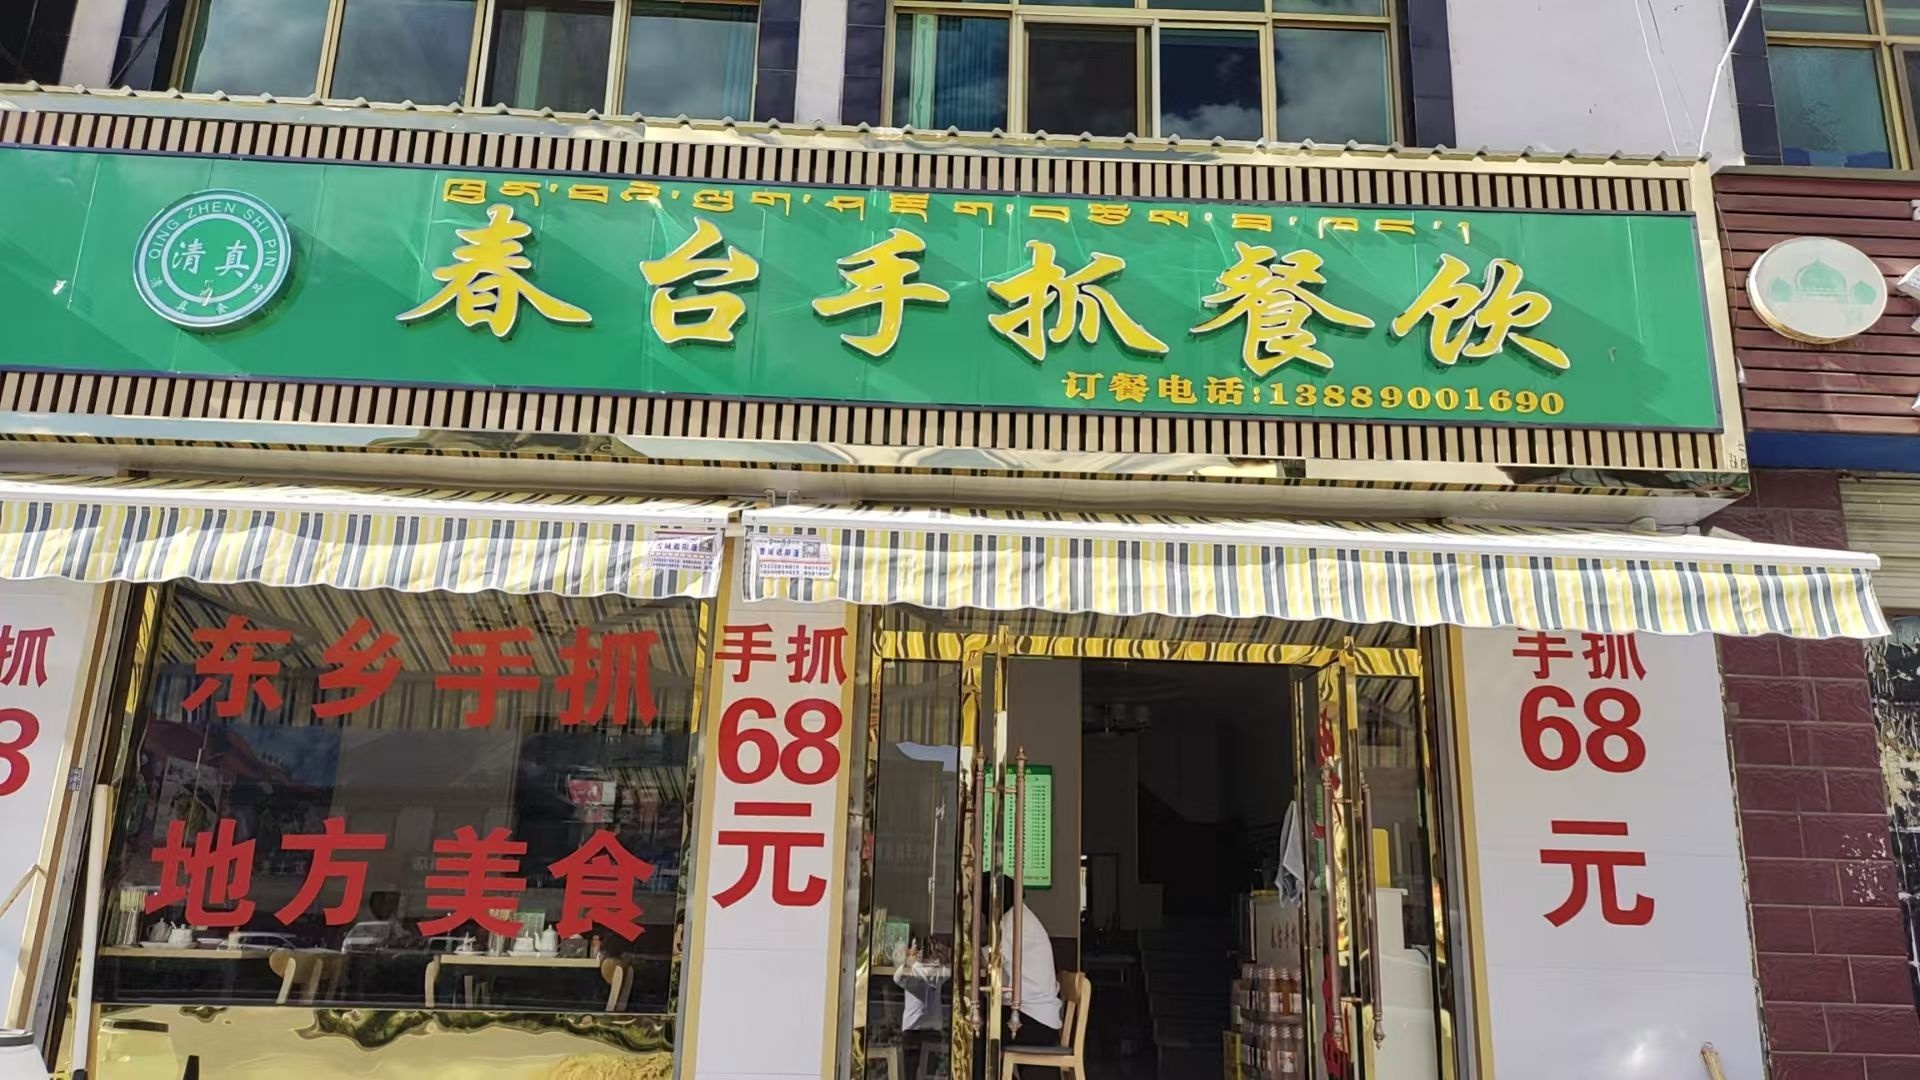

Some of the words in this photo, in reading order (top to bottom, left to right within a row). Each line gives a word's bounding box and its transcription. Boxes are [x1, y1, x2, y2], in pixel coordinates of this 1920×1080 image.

[149, 219, 180, 260] QING
[185, 201, 236, 220] ZHEN
[243, 208, 270, 233] SHI
[263, 238, 278, 268] PIN
[171, 238, 250, 279] 清真
[394, 204, 1571, 376] 春台手抓餐饮
[181, 614, 660, 729] 东乡手抓
[714, 624, 849, 686] 手抓
[1512, 629, 1647, 681] 手抓
[718, 697, 843, 785] 68
[1520, 685, 1646, 773] 68
[144, 816, 654, 943] 地方美食
[712, 802, 827, 909] 元
[1540, 820, 1655, 928] 元
